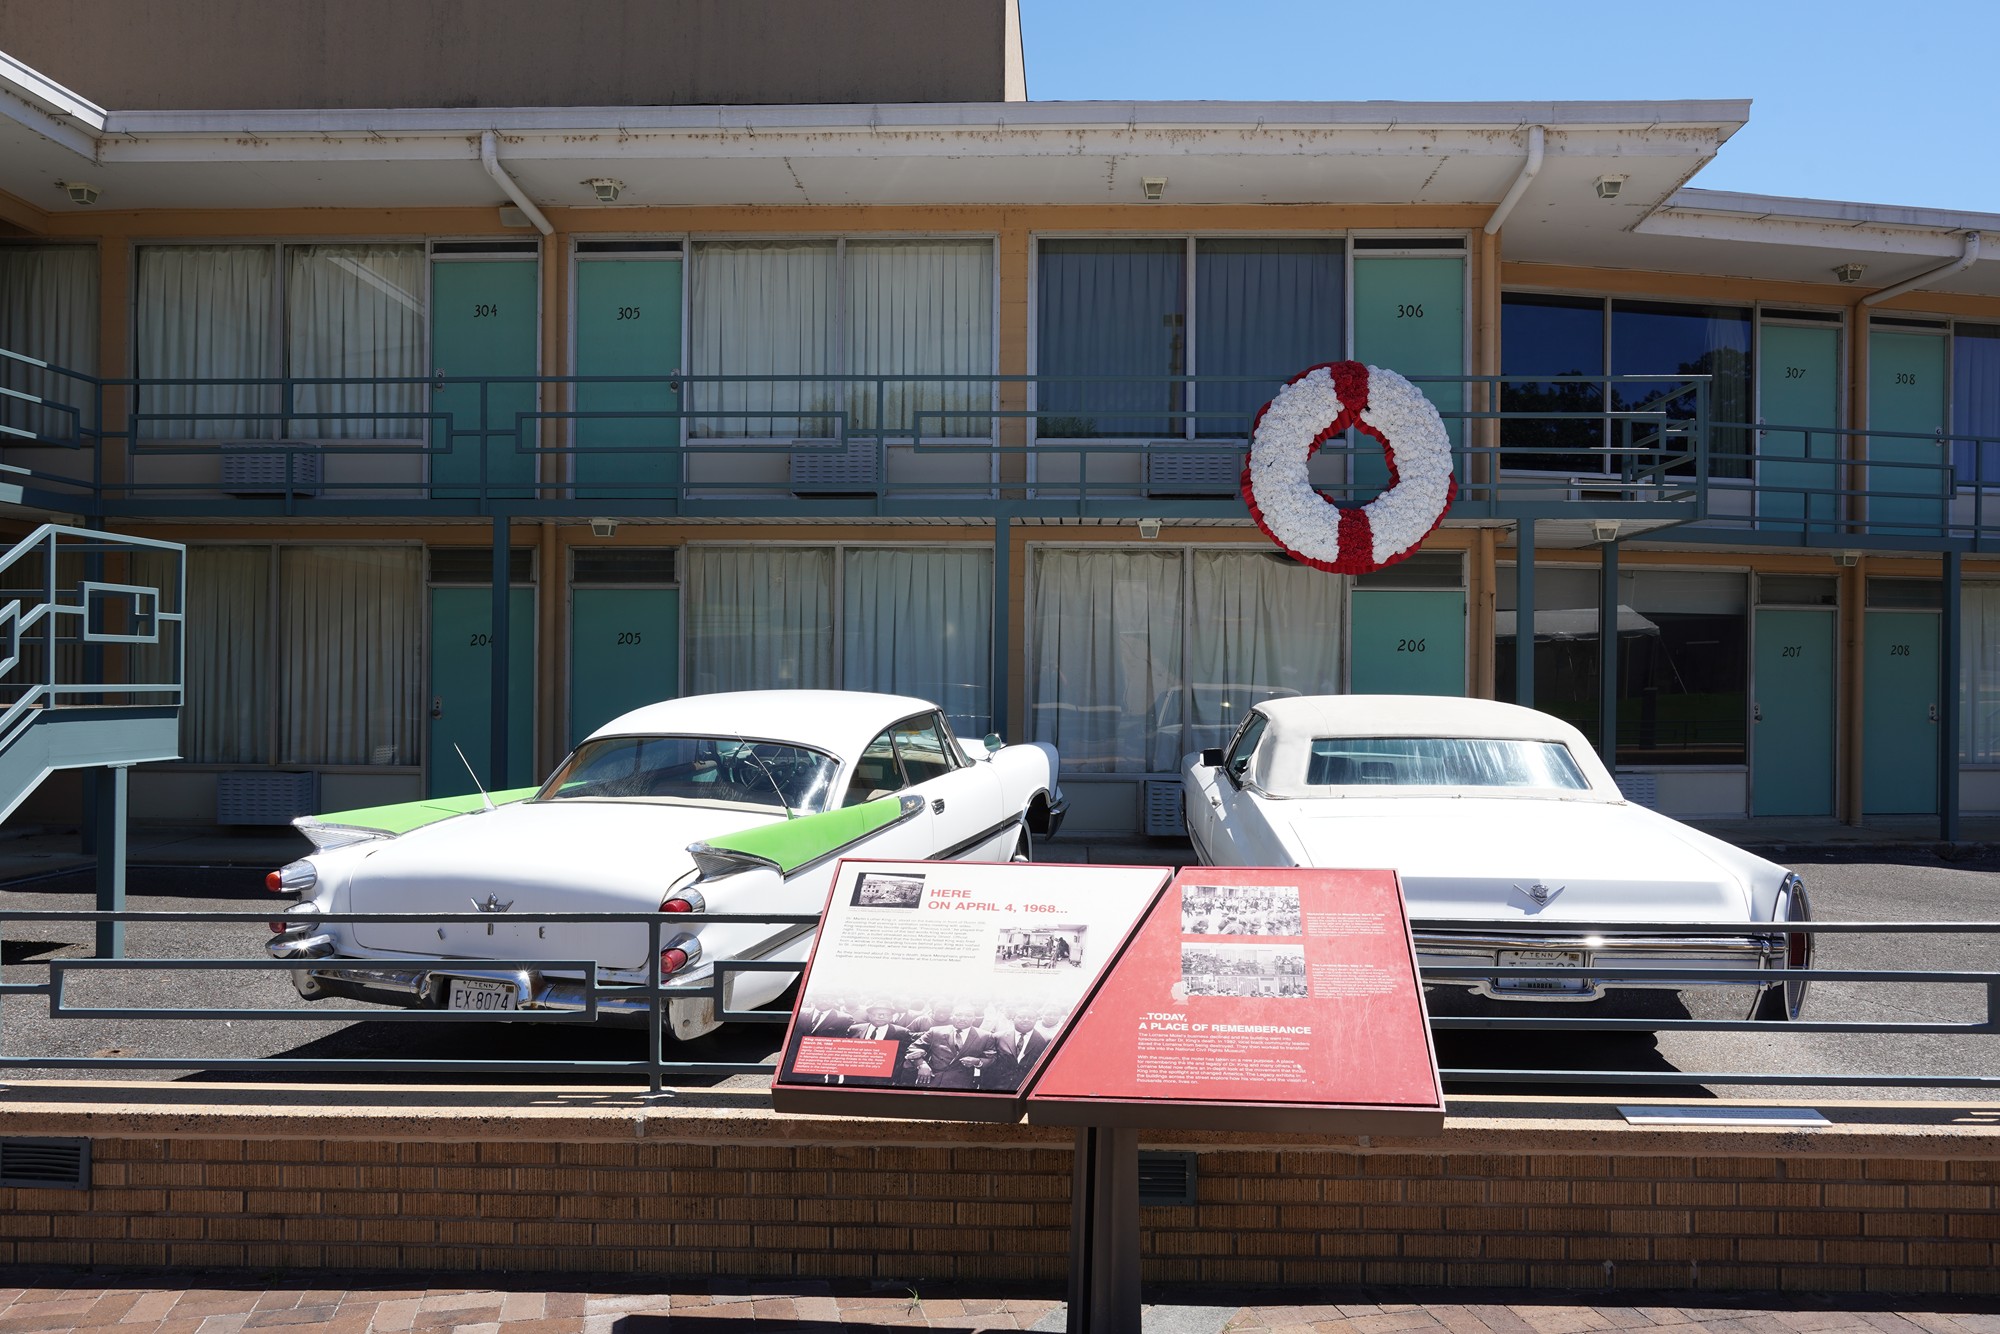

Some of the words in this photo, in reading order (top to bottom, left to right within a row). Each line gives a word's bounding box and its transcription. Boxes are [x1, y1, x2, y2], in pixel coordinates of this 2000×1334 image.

[474, 304, 497, 317] 304
[617, 306, 641, 320] 305
[1397, 304, 1424, 318] 306
[1785, 367, 1806, 378] 307
[1895, 373, 1916, 385] 308
[617, 632, 642, 646] 205
[1397, 639, 1426, 653] 206
[1782, 645, 1802, 657] 207
[1890, 645, 1910, 656] 208
[930, 889, 972, 898] HERE
[928, 901, 950, 910] ON
[955, 902, 1000, 911] APRIL
[1005, 903, 1017, 913] 4,
[1023, 904, 1068, 913] 1968...
[1139, 1013, 1188, 1022] ...TODAY,
[1212, 1024, 1312, 1034] REMEMBERANCE
